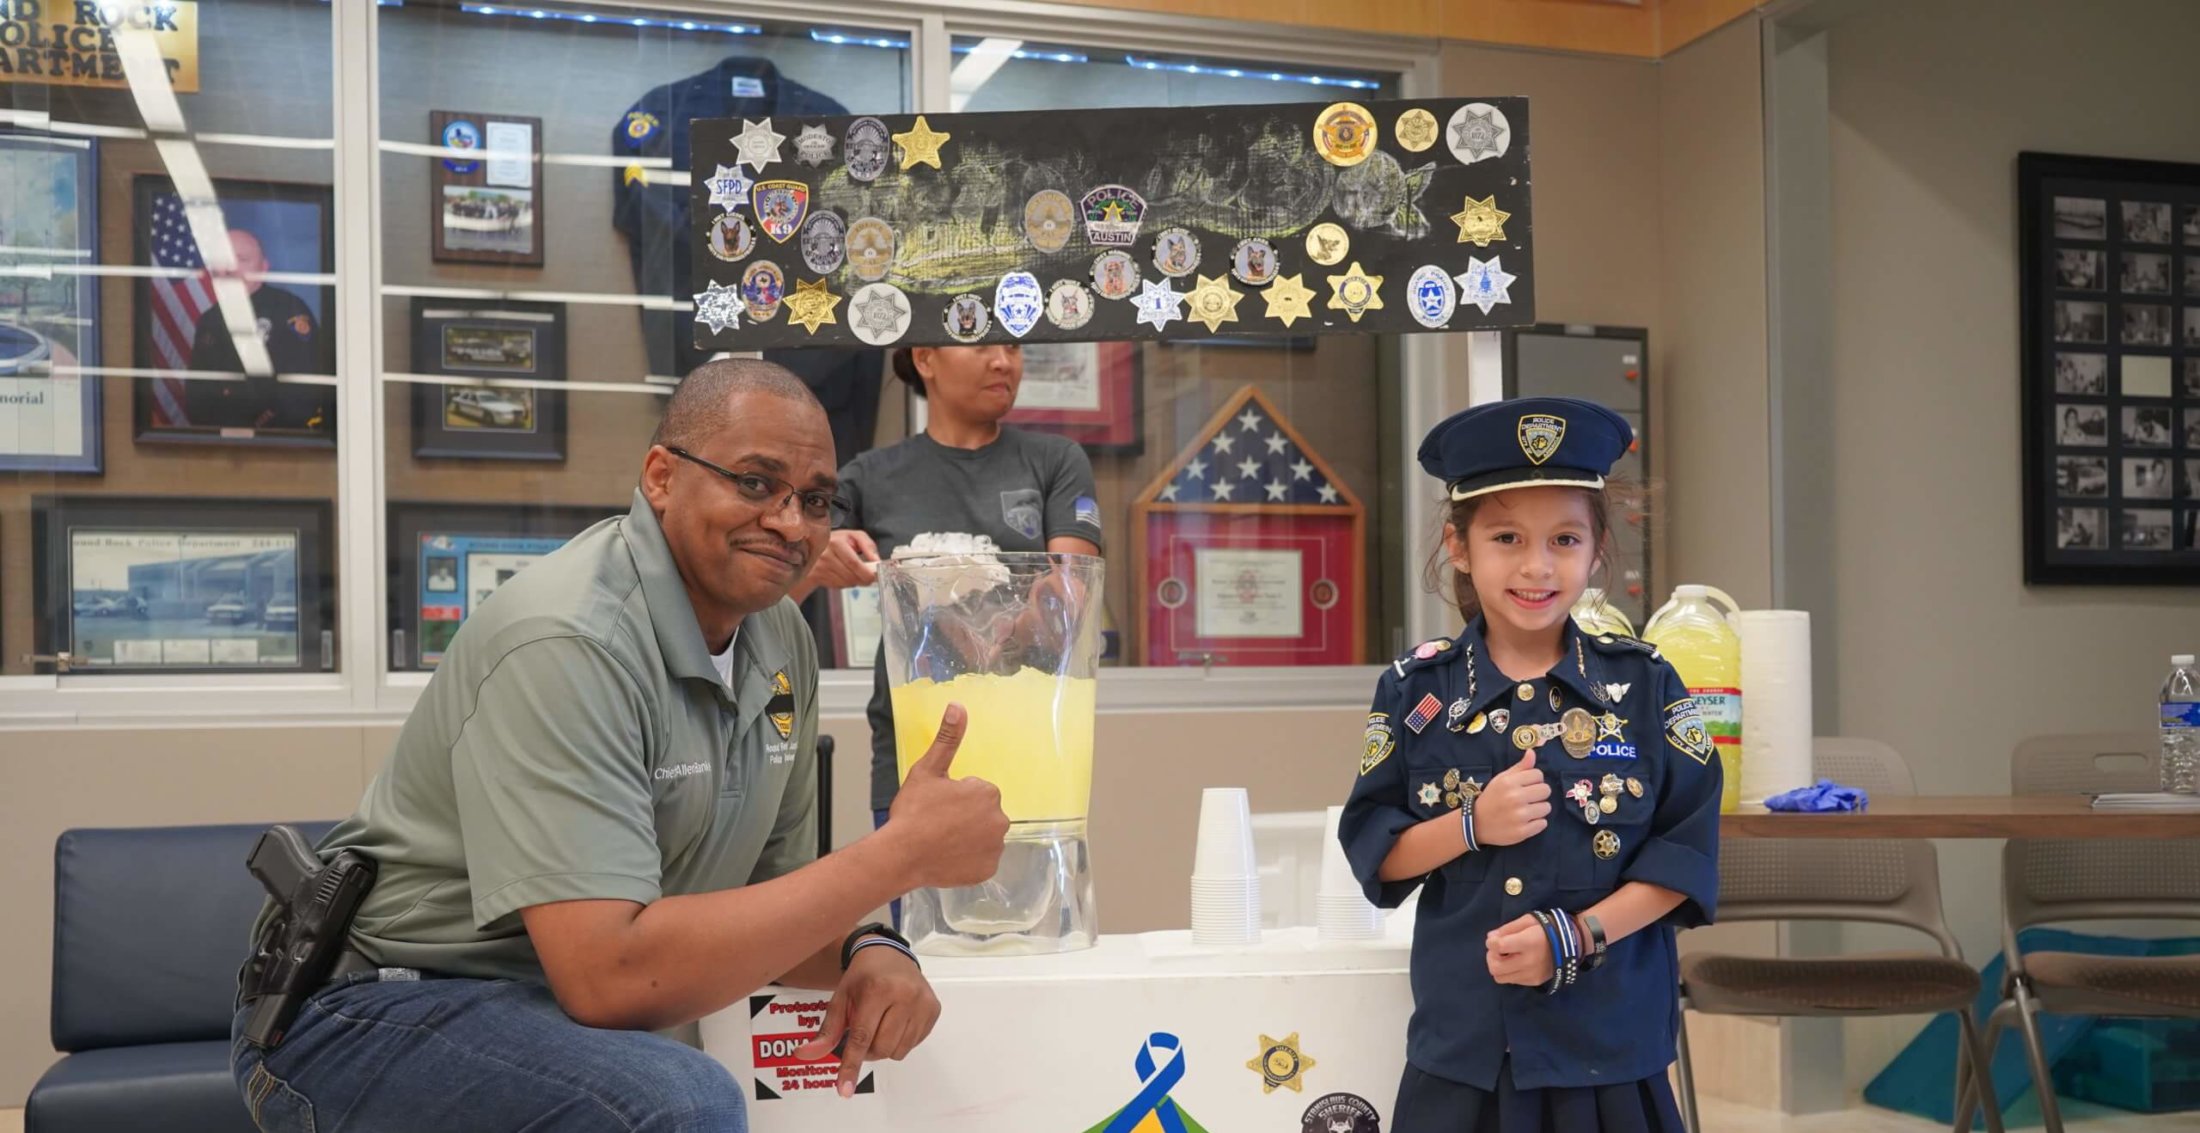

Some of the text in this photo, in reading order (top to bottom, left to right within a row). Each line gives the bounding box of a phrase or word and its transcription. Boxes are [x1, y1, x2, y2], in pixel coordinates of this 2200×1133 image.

[74, 0, 178, 31] ROCK
[0, 47, 180, 83] ARTMET
[716, 179, 742, 194] SFPD
[1087, 189, 1140, 210] POLICE
[770, 223, 793, 235] K9
[1093, 232, 1132, 242] AUSTIN
[1693, 696, 1726, 705] EYSER
[1592, 744, 1637, 758] POLICE
[769, 1001, 831, 1014] Protect
[776, 1065, 840, 1078] Monitore
[781, 1078, 838, 1091] 24 hour
[1304, 1095, 1377, 1124] STANISLAUS COUNTY
[1318, 1104, 1364, 1120] SHERIFF
